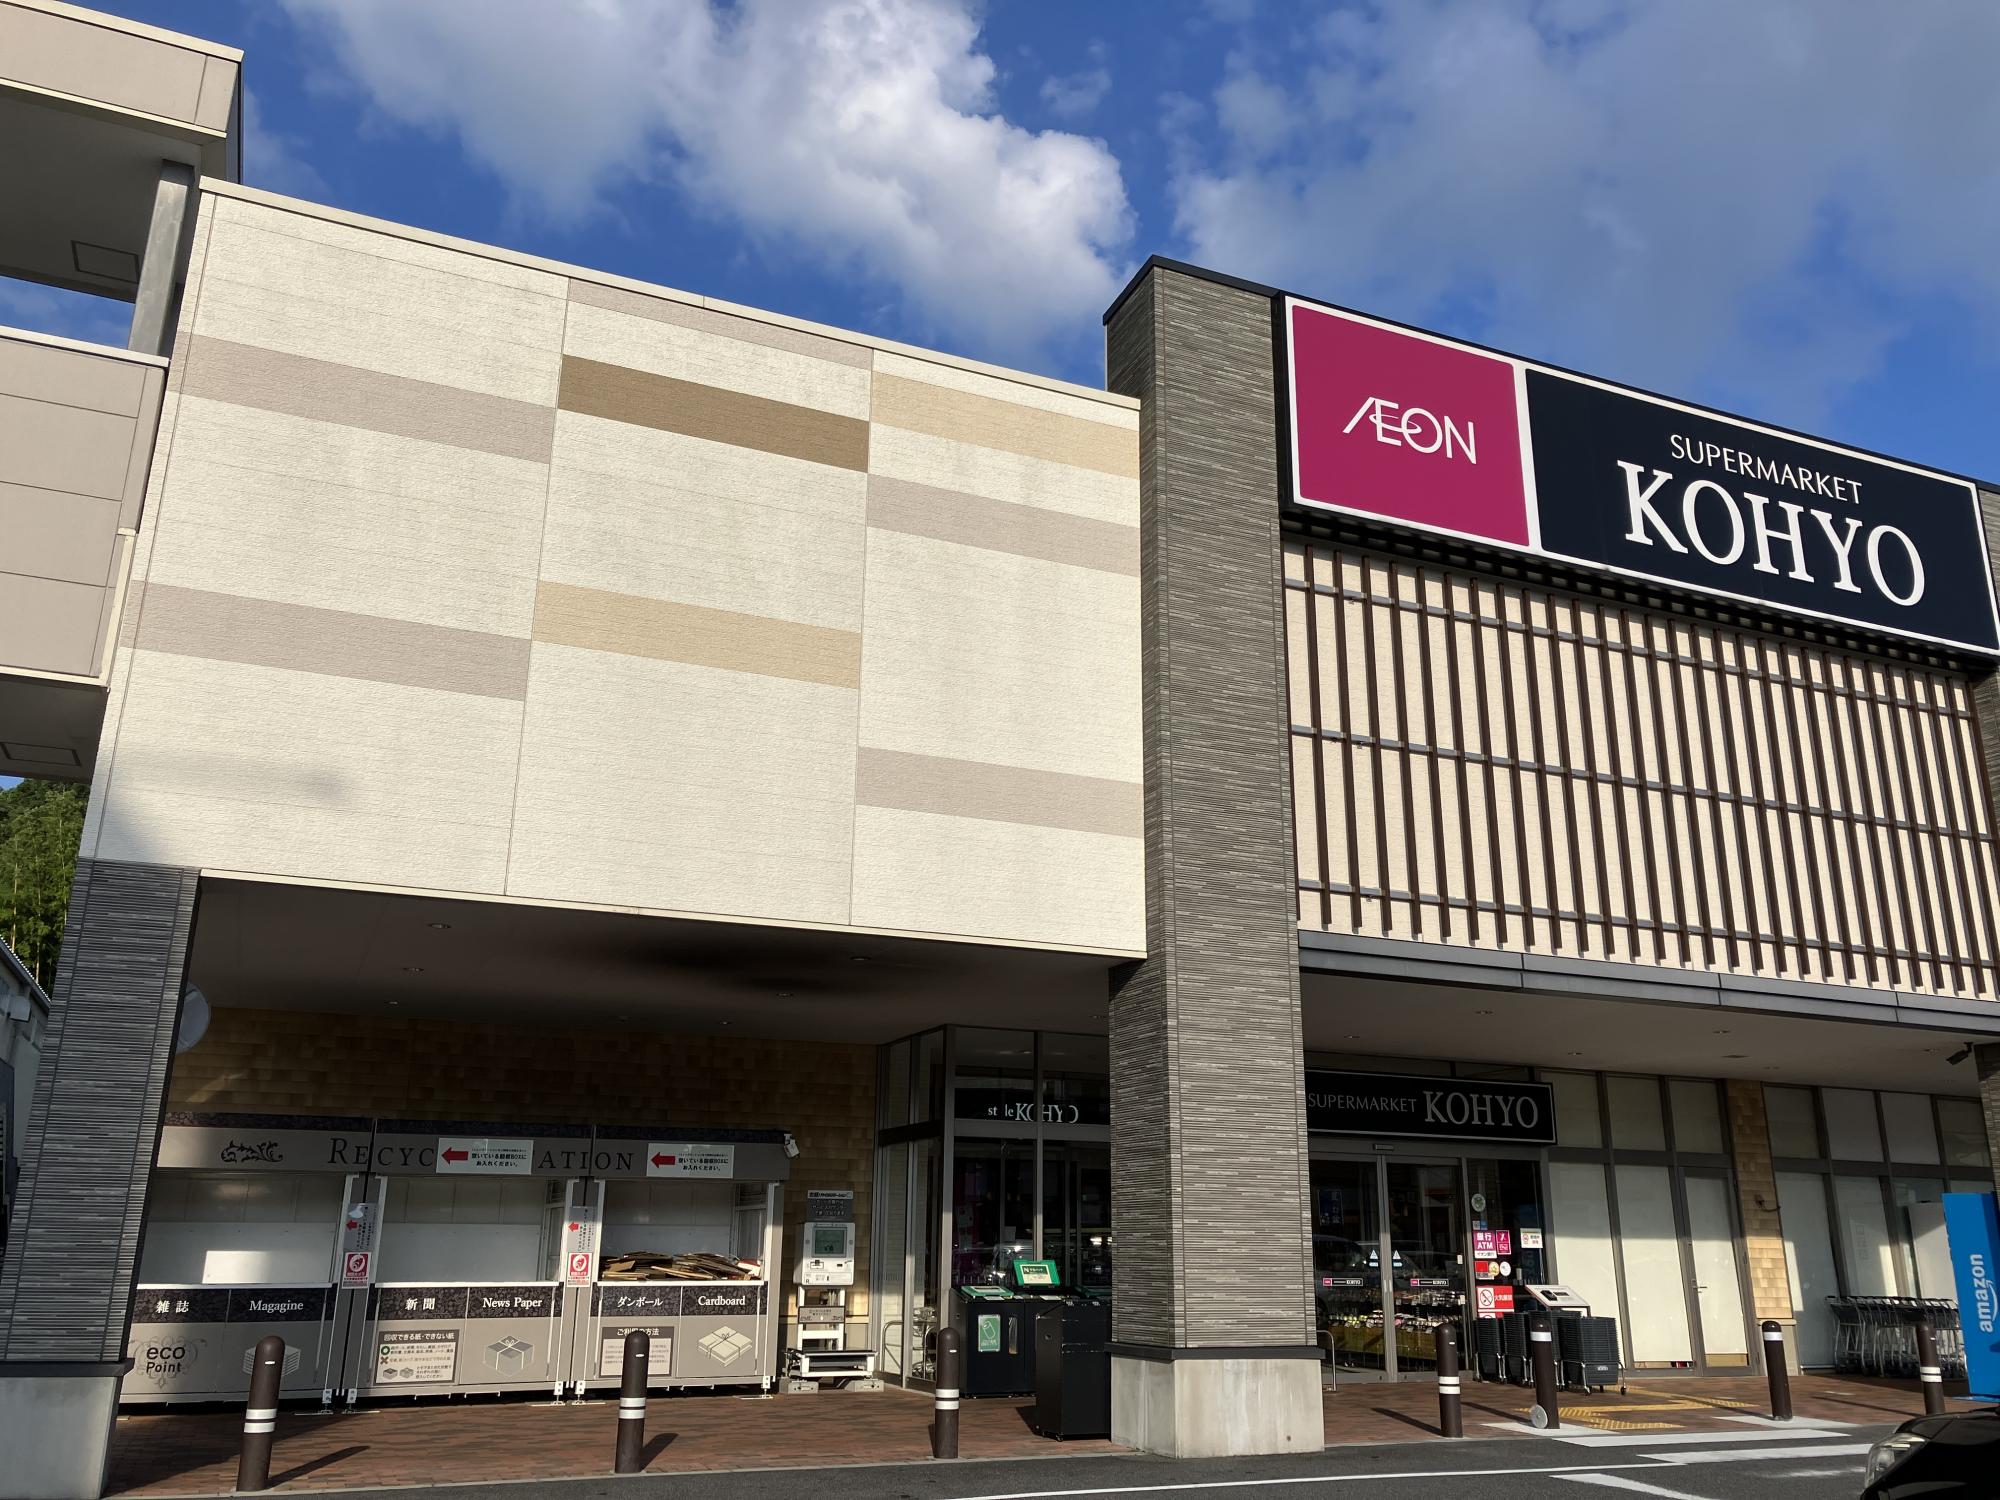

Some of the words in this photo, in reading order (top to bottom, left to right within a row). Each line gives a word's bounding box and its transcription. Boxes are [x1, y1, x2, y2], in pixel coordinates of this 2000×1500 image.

[1671, 434, 1862, 504] SUPERMARKET
[1617, 460, 1925, 607] KOHYO
[1308, 1093, 1417, 1112] SUPERMARKET
[1423, 1091, 1538, 1128] KOHYO
[1477, 1242, 1493, 1250] ATM
[1970, 1254, 1994, 1333] amazon
[156, 1300, 189, 1314] 雑誌
[249, 1300, 304, 1313] Magagine
[405, 1298, 436, 1311] 新聞
[483, 1298, 511, 1308] News
[514, 1297, 543, 1310] Paper
[617, 1296, 664, 1308] ダンボール
[698, 1295, 746, 1306] Cardboard
[146, 1346, 186, 1360] eco
[146, 1362, 182, 1373] Point
